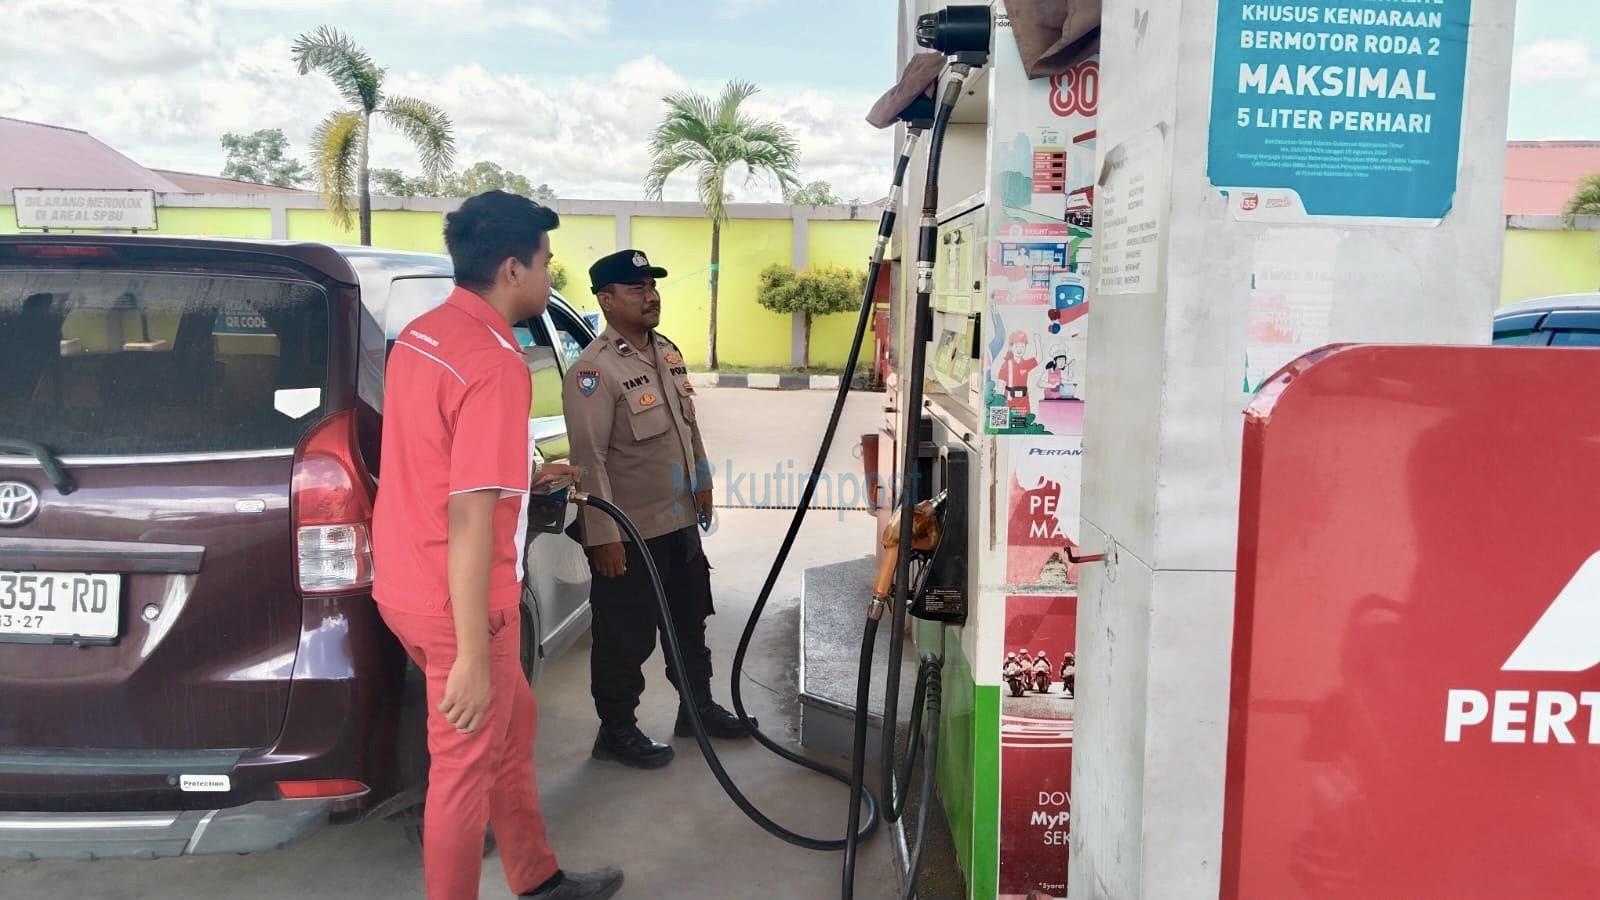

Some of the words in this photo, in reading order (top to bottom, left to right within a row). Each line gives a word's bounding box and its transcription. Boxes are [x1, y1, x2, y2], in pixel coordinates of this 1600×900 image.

[1241, 5, 1319, 22] KHUSUS
[1324, 7, 1442, 28] KENDARAAN
[1240, 30, 1358, 52] BERMOTOR
[1365, 35, 1422, 55] RODA
[1427, 38, 1440, 56] 2
[1049, 59, 1098, 118] 80
[1238, 63, 1437, 101] MAKSIMAL
[1237, 108, 1250, 128] 5
[1256, 109, 1323, 130] LITER
[1329, 111, 1431, 133] PERHARI
[25, 196, 85, 208] DILARANG
[86, 197, 143, 208] MEROKOK
[50, 210, 89, 221] AREAL
[92, 210, 124, 222] SPBU
[71, 577, 108, 614] RD
